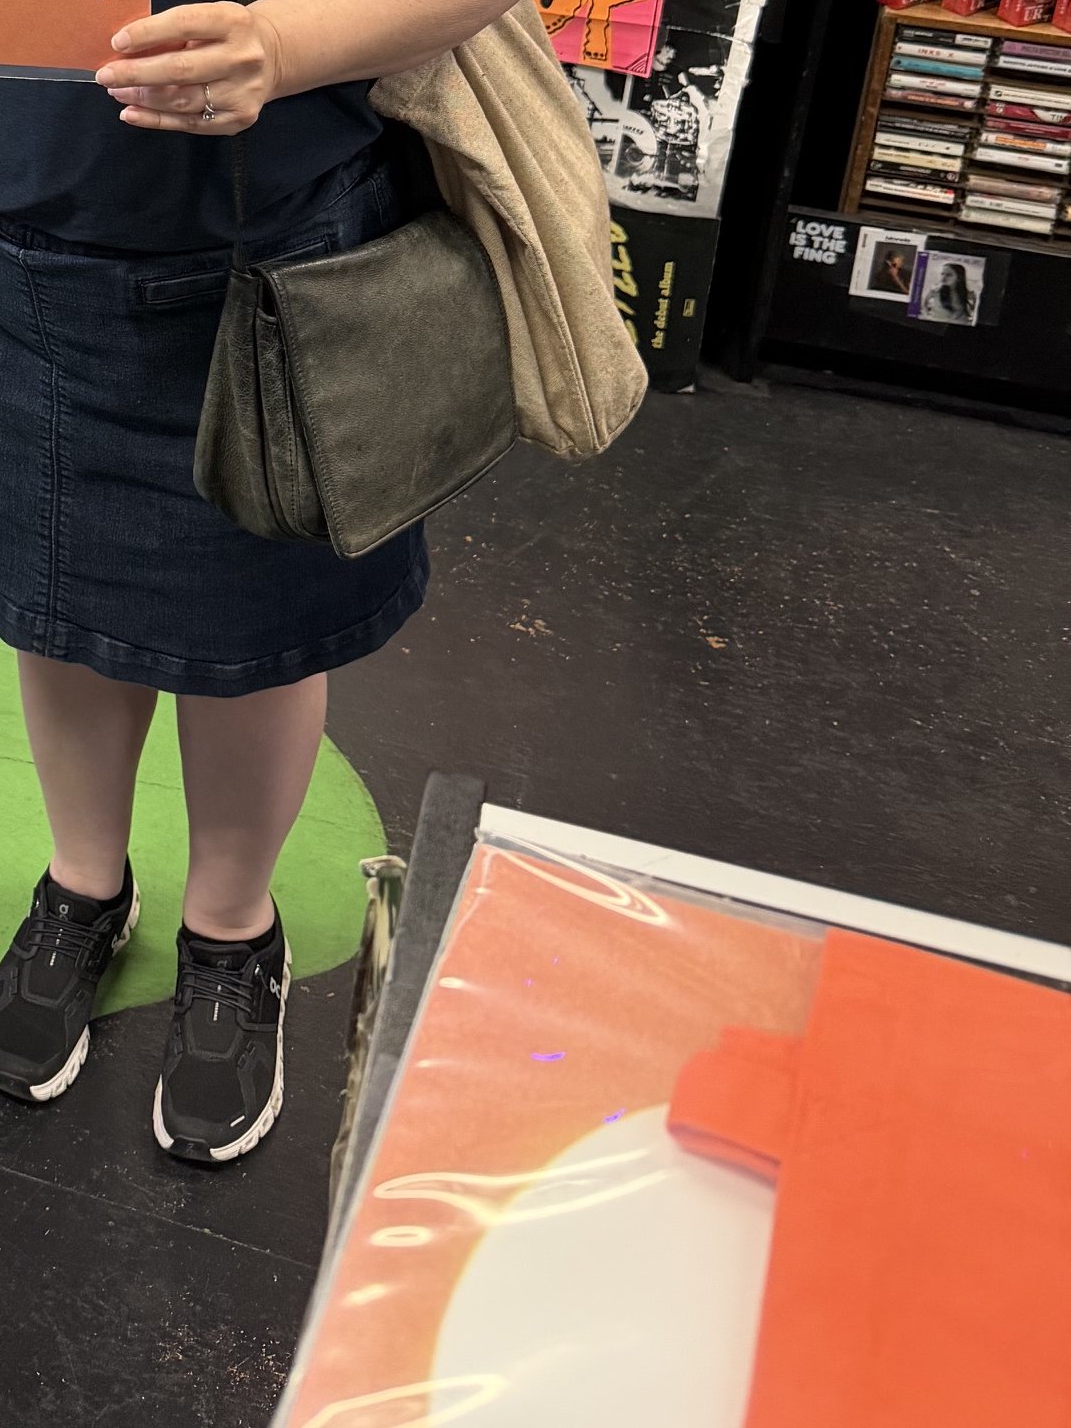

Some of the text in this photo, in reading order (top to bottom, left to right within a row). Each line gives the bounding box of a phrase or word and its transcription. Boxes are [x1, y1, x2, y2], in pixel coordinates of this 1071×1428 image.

[795, 220, 846, 240] LOVE
[788, 231, 848, 254] IS THE
[651, 261, 676, 350] the debut album
